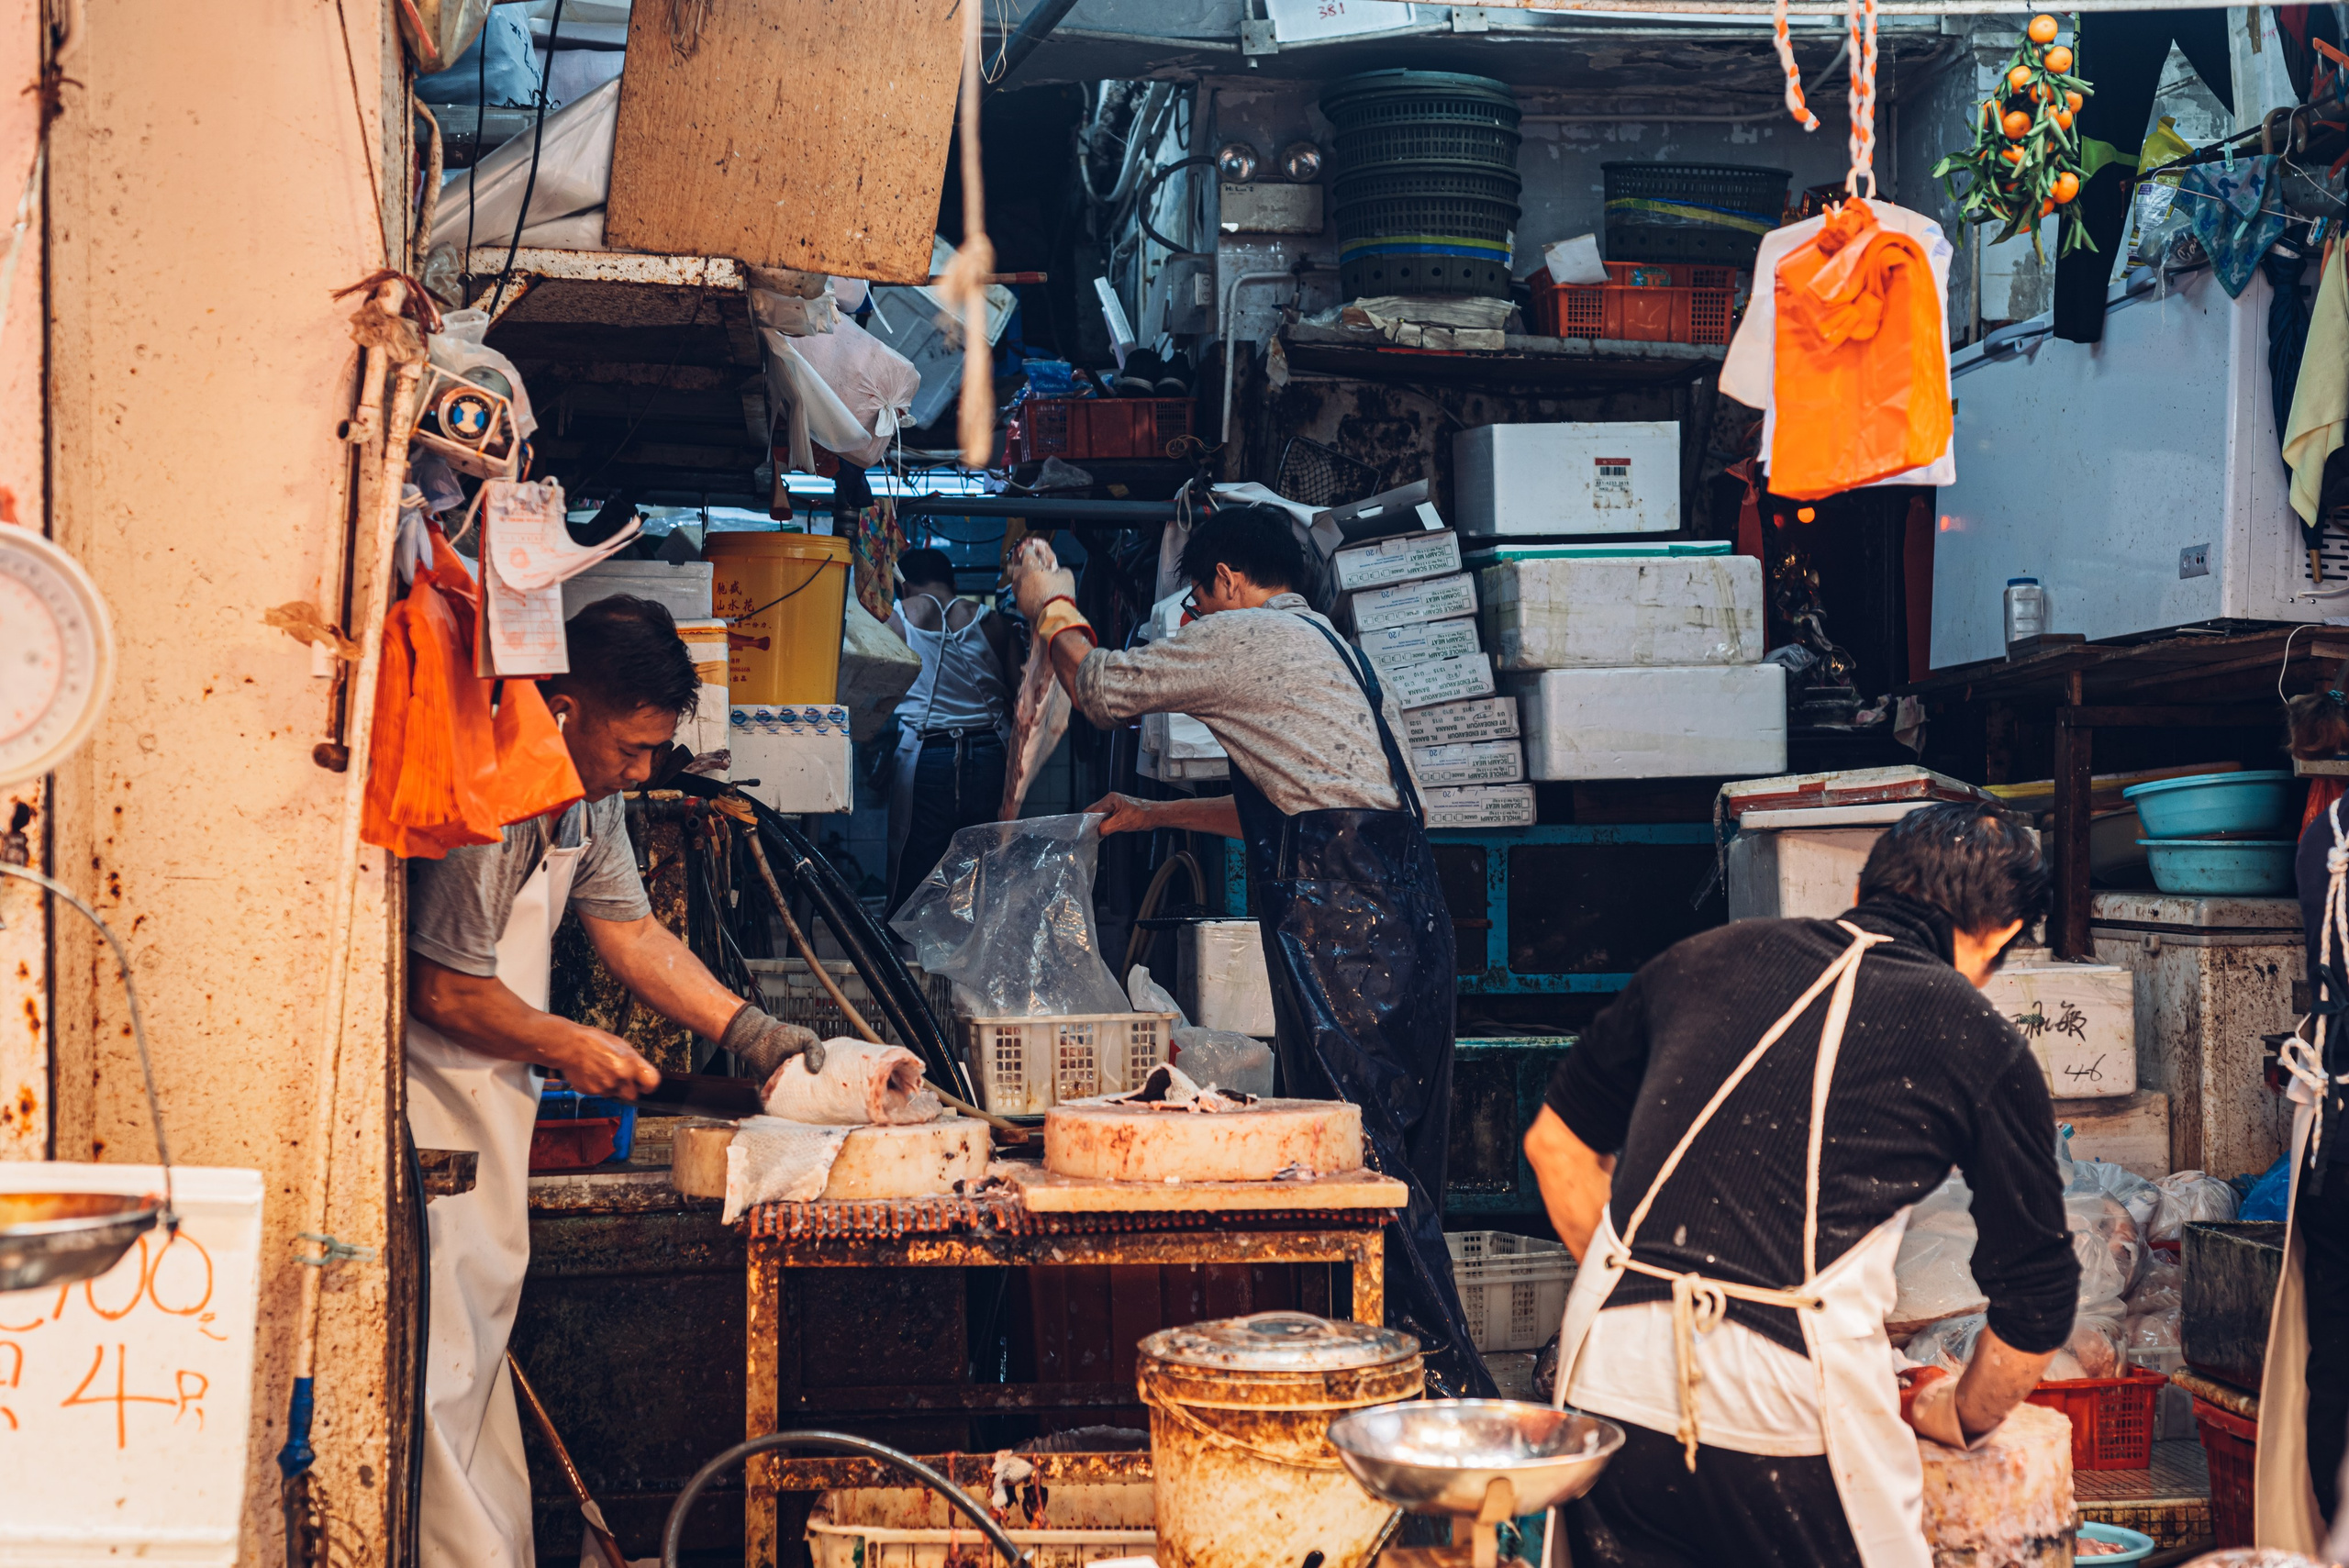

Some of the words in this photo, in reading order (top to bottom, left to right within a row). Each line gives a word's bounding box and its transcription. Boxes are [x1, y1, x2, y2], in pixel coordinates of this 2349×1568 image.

[1429, 563, 1447, 572] WHOLE
[713, 598, 754, 612] 山水花
[1439, 679, 1470, 689] ENDEAVOUR
[1408, 687, 1430, 695] BANANA
[1420, 691, 1452, 701] ENDEAVOUR
[1466, 720, 1497, 728] ENDEAVOUR
[1448, 730, 1479, 739] ENDEAVOUR
[2065, 1053, 2106, 1082] 46
